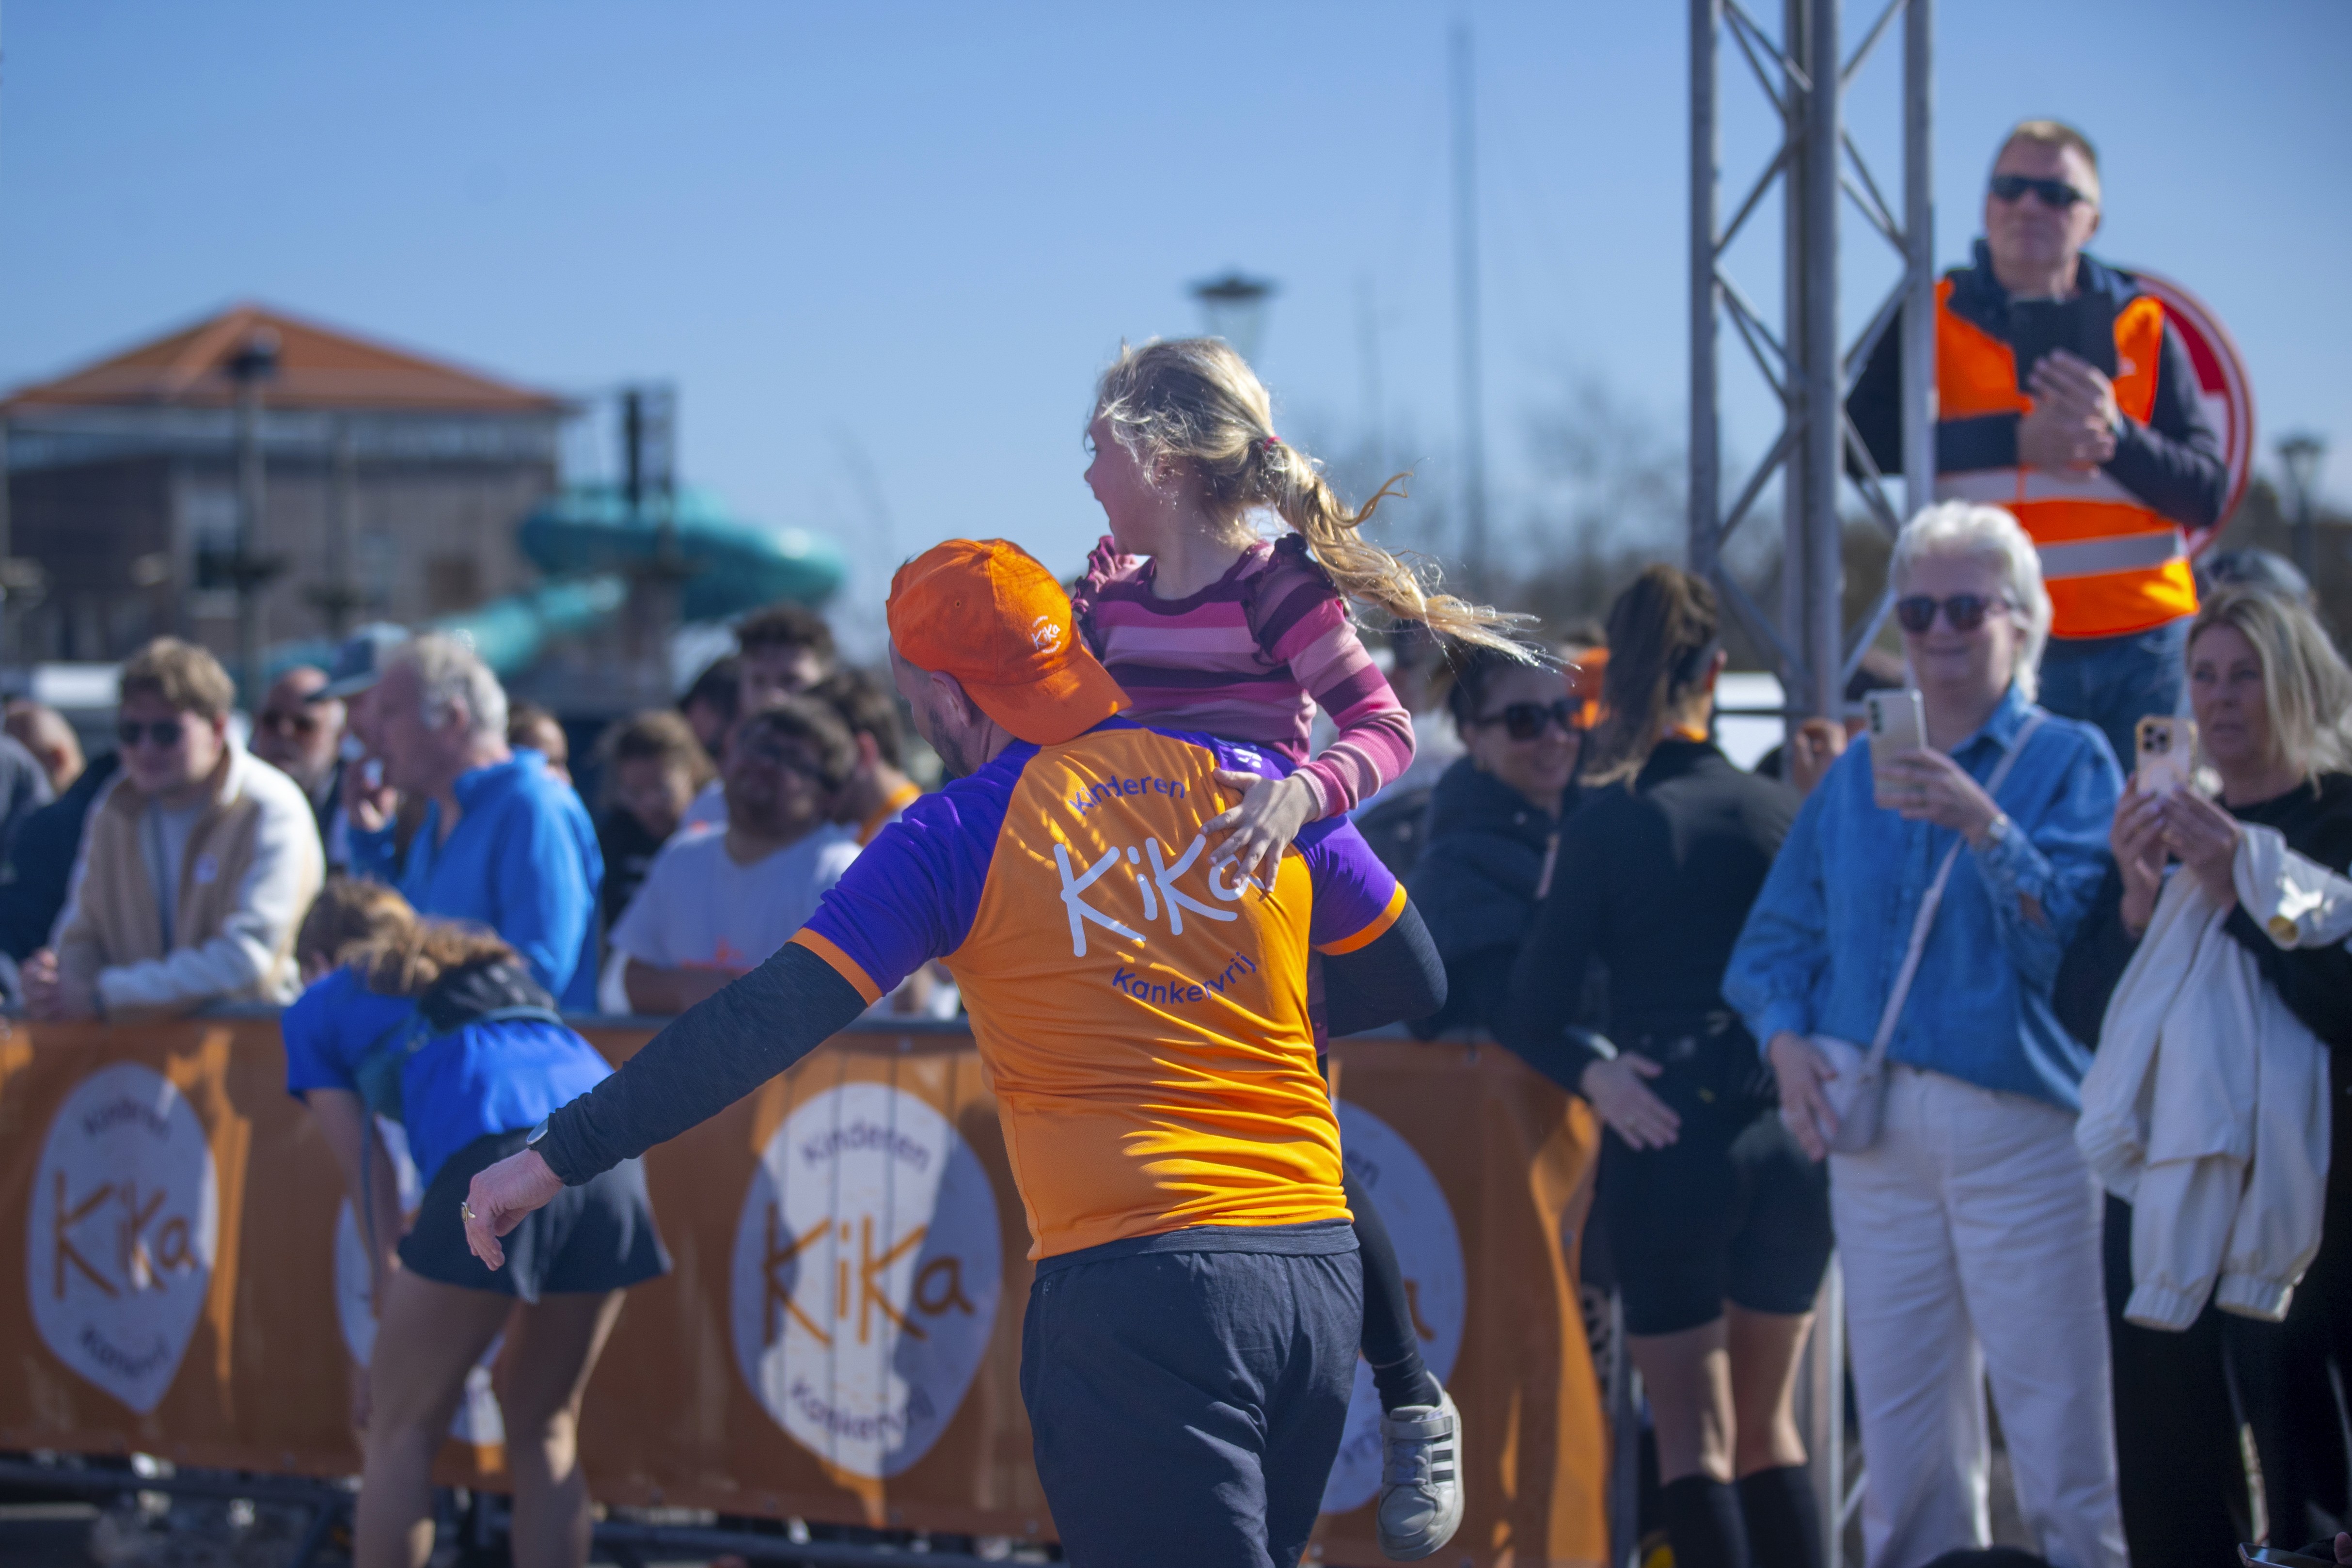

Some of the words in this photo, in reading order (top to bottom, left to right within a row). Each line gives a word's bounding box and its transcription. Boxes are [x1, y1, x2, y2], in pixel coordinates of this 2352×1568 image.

[1069, 775, 1186, 816] Kinderen
[1054, 833, 1265, 958] KiKa
[1112, 951, 1257, 1005] Kankervrij
[764, 1202, 976, 1347] KiKa
